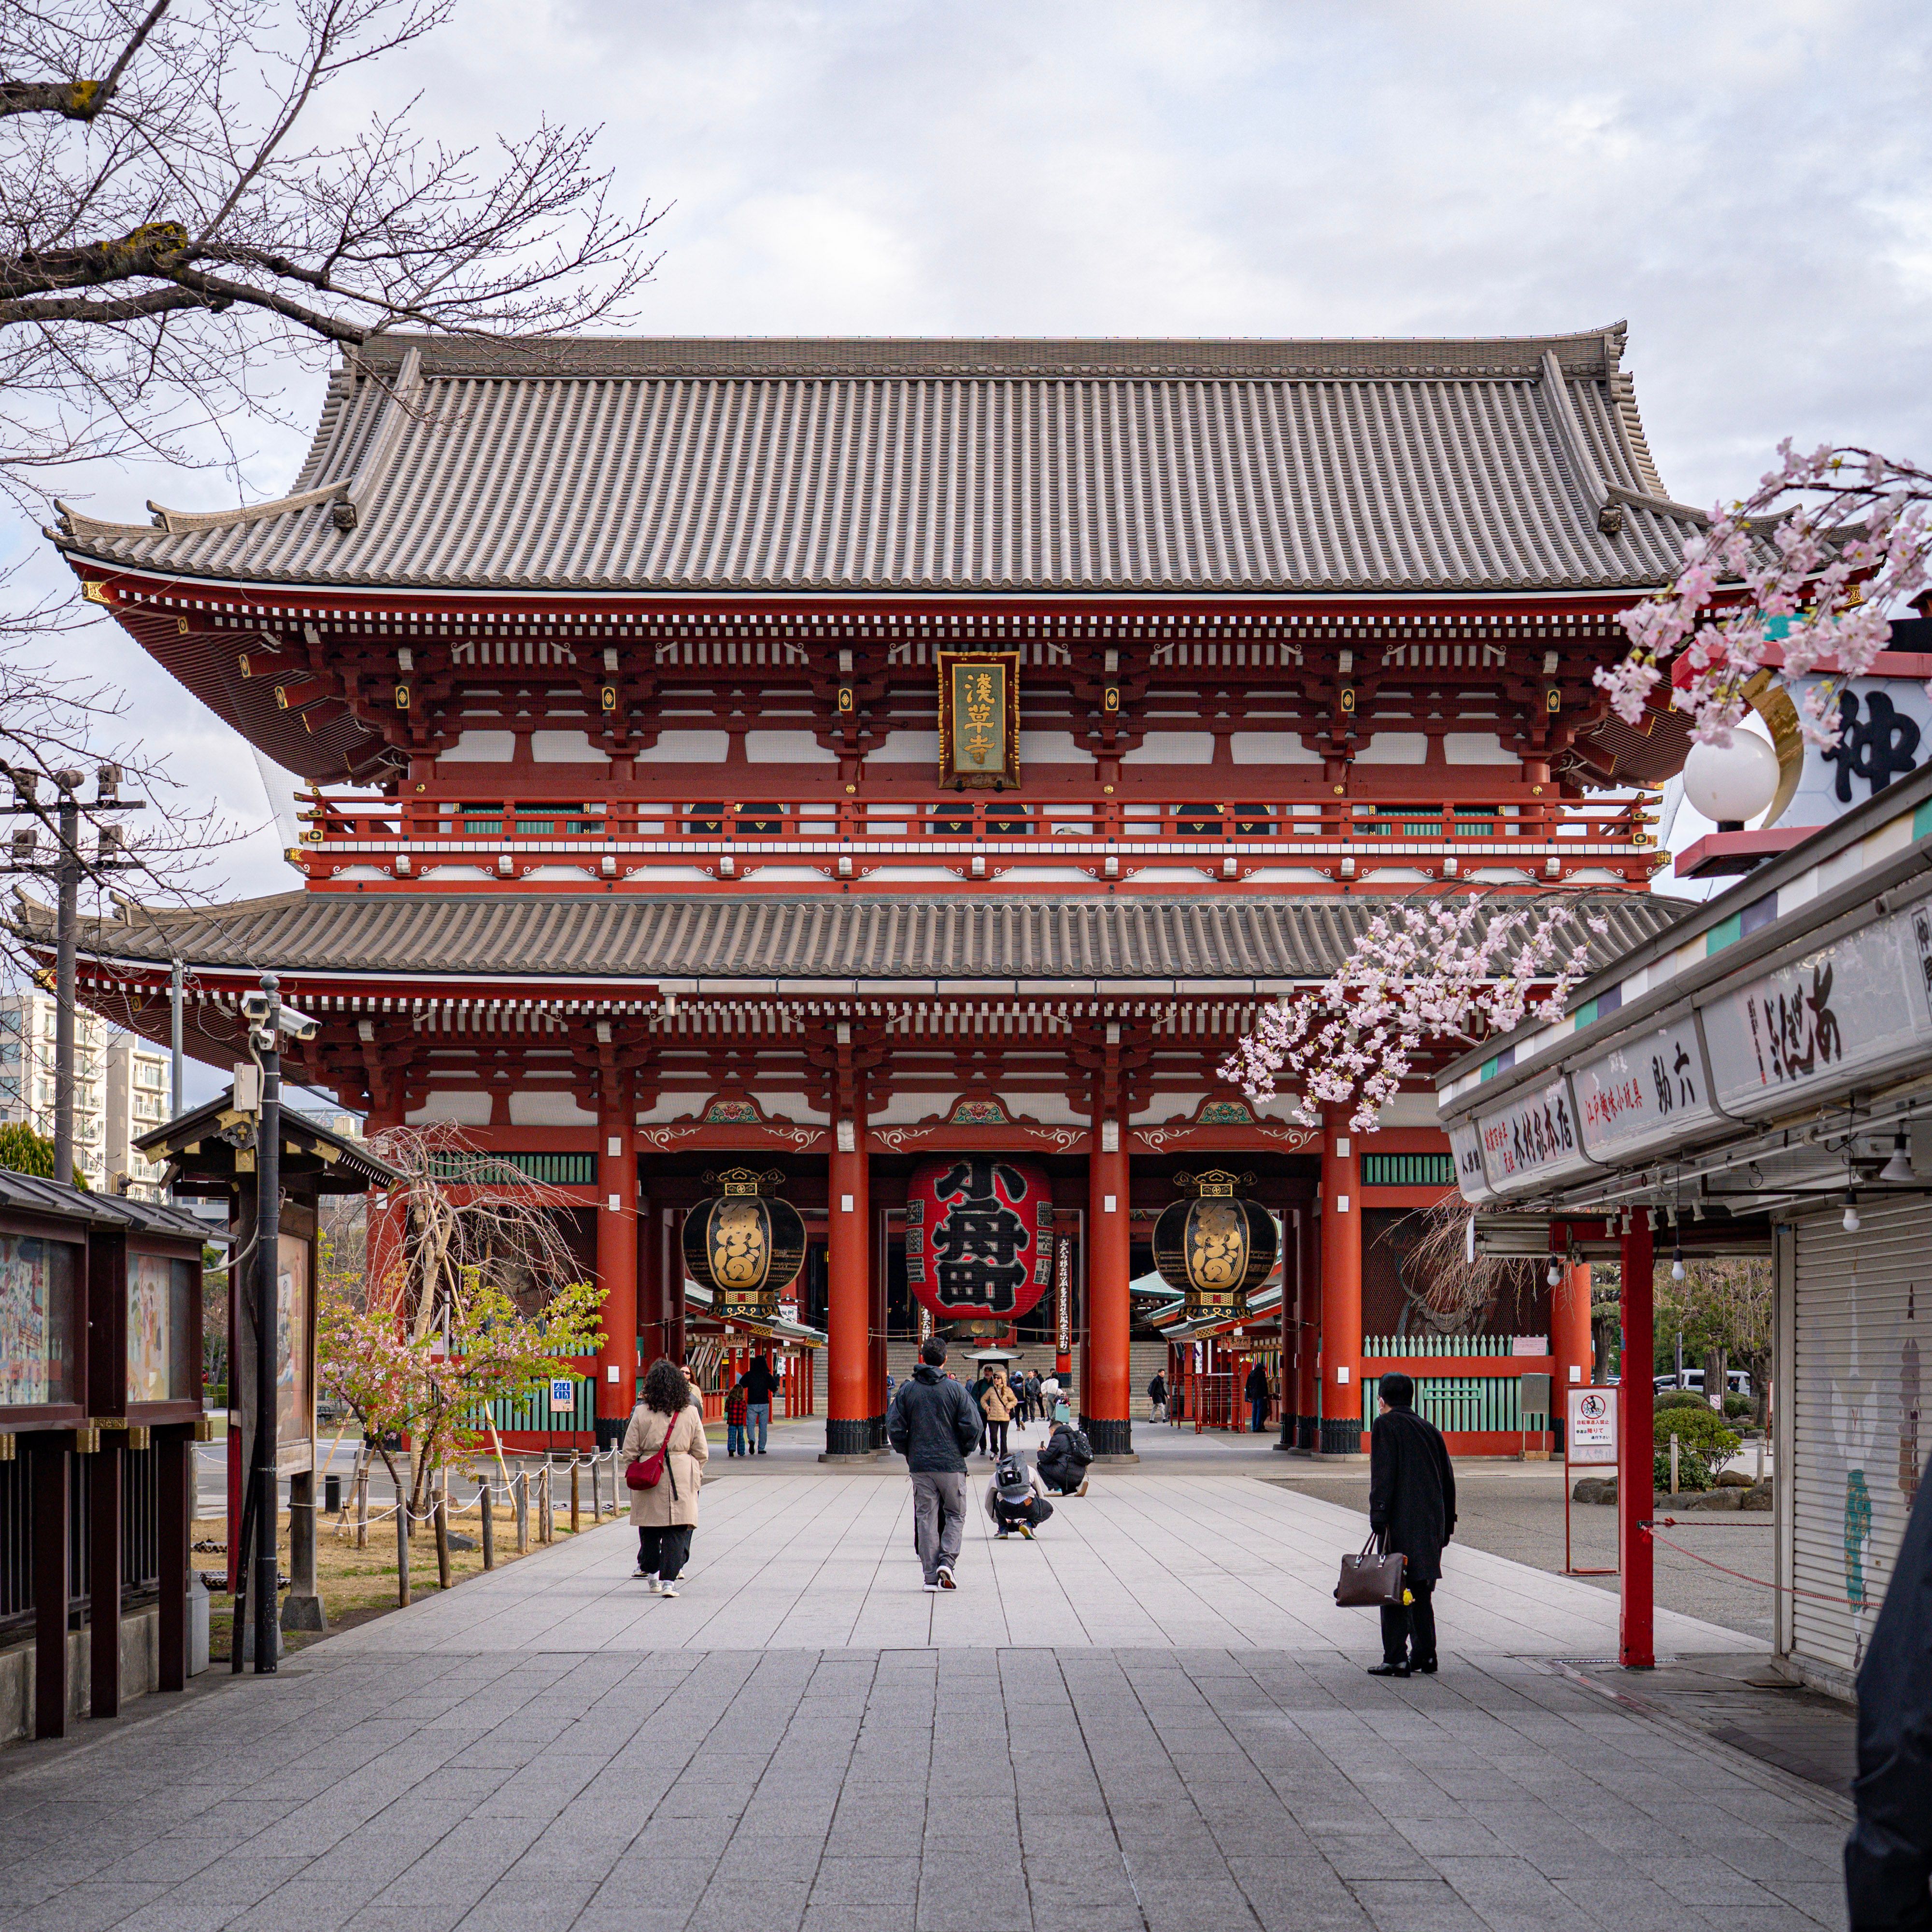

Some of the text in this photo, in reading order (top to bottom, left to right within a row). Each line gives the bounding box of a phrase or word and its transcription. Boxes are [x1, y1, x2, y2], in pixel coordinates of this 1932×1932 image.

[1585, 1078, 1643, 1126] 江戸趣味小玩具
[1652, 1041, 1695, 1115] 助六
[1512, 1095, 1573, 1170] 木村家本店
[932, 1161, 1030, 1313] 小舟町
